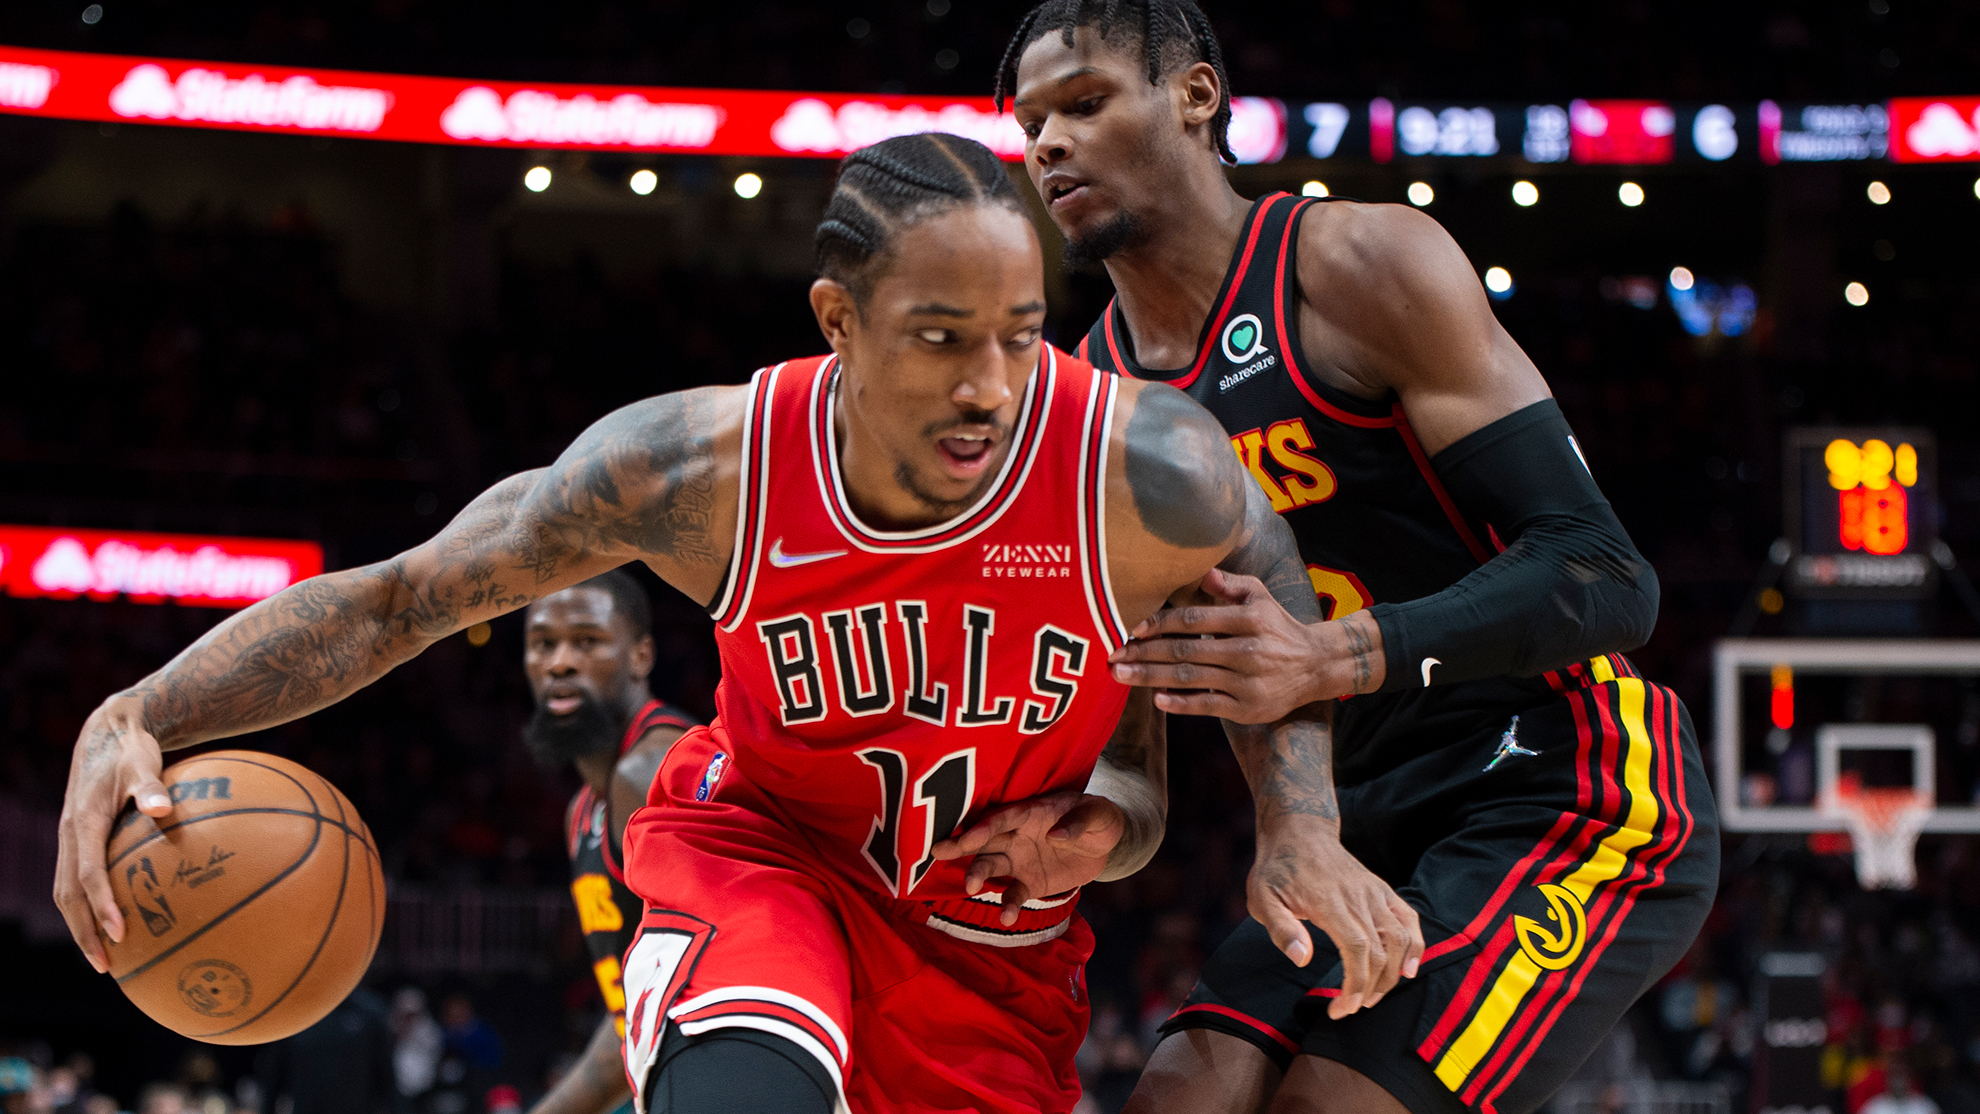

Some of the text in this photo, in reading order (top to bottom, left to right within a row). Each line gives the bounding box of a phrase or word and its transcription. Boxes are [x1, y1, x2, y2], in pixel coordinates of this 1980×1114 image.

[1302, 102, 1350, 159] 7
[1692, 104, 1738, 161] 6
[1219, 354, 1276, 391] sharecare
[982, 566, 1071, 578] EYEWEAR
[983, 544, 1071, 563] ZENNI
[756, 600, 1090, 735] BULLS
[853, 746, 977, 899] 11
